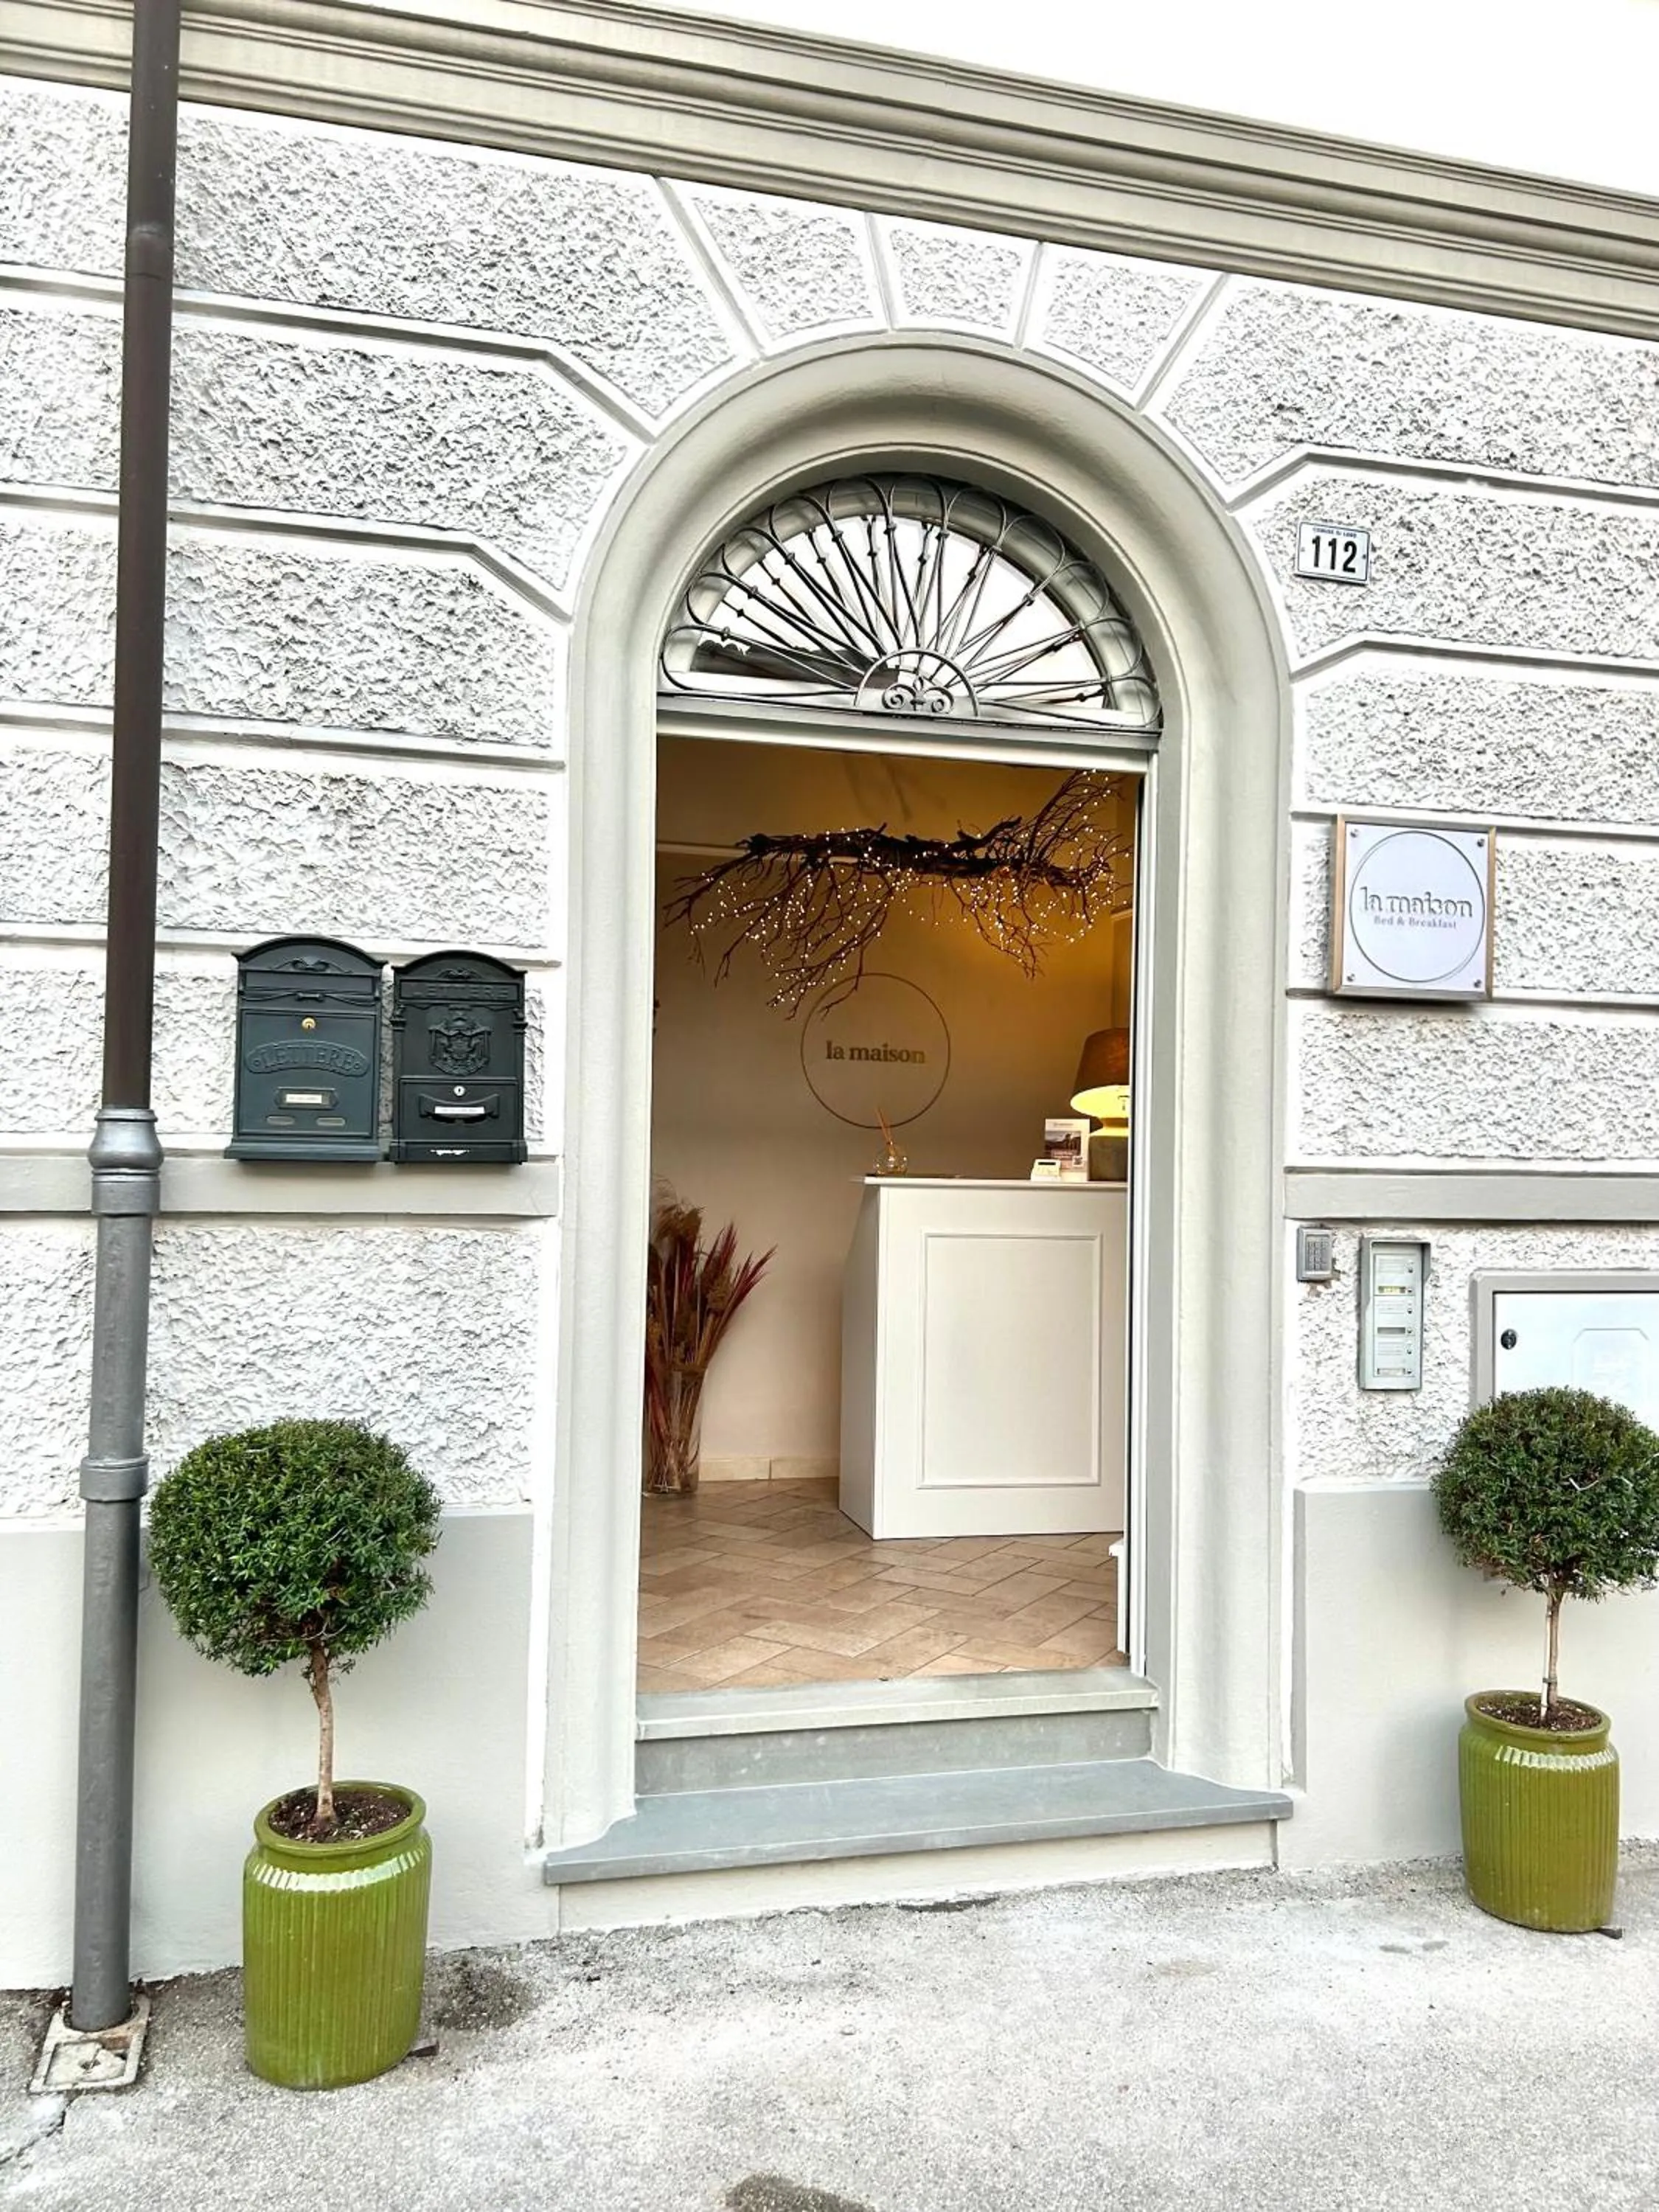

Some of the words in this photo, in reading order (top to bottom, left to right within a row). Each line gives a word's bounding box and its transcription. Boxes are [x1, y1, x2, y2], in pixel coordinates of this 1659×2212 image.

[1312, 535, 1357, 573] 112
[1360, 886, 1382, 911] la
[1386, 891, 1473, 918] maison
[1374, 916, 1394, 926] Bed
[1397, 917, 1405, 926] &
[1408, 917, 1456, 929] Breakfast
[411, 981, 509, 999] LETTERE
[261, 1044, 356, 1070] LETTERE
[826, 1040, 844, 1060] la
[849, 1043, 925, 1063] maison
